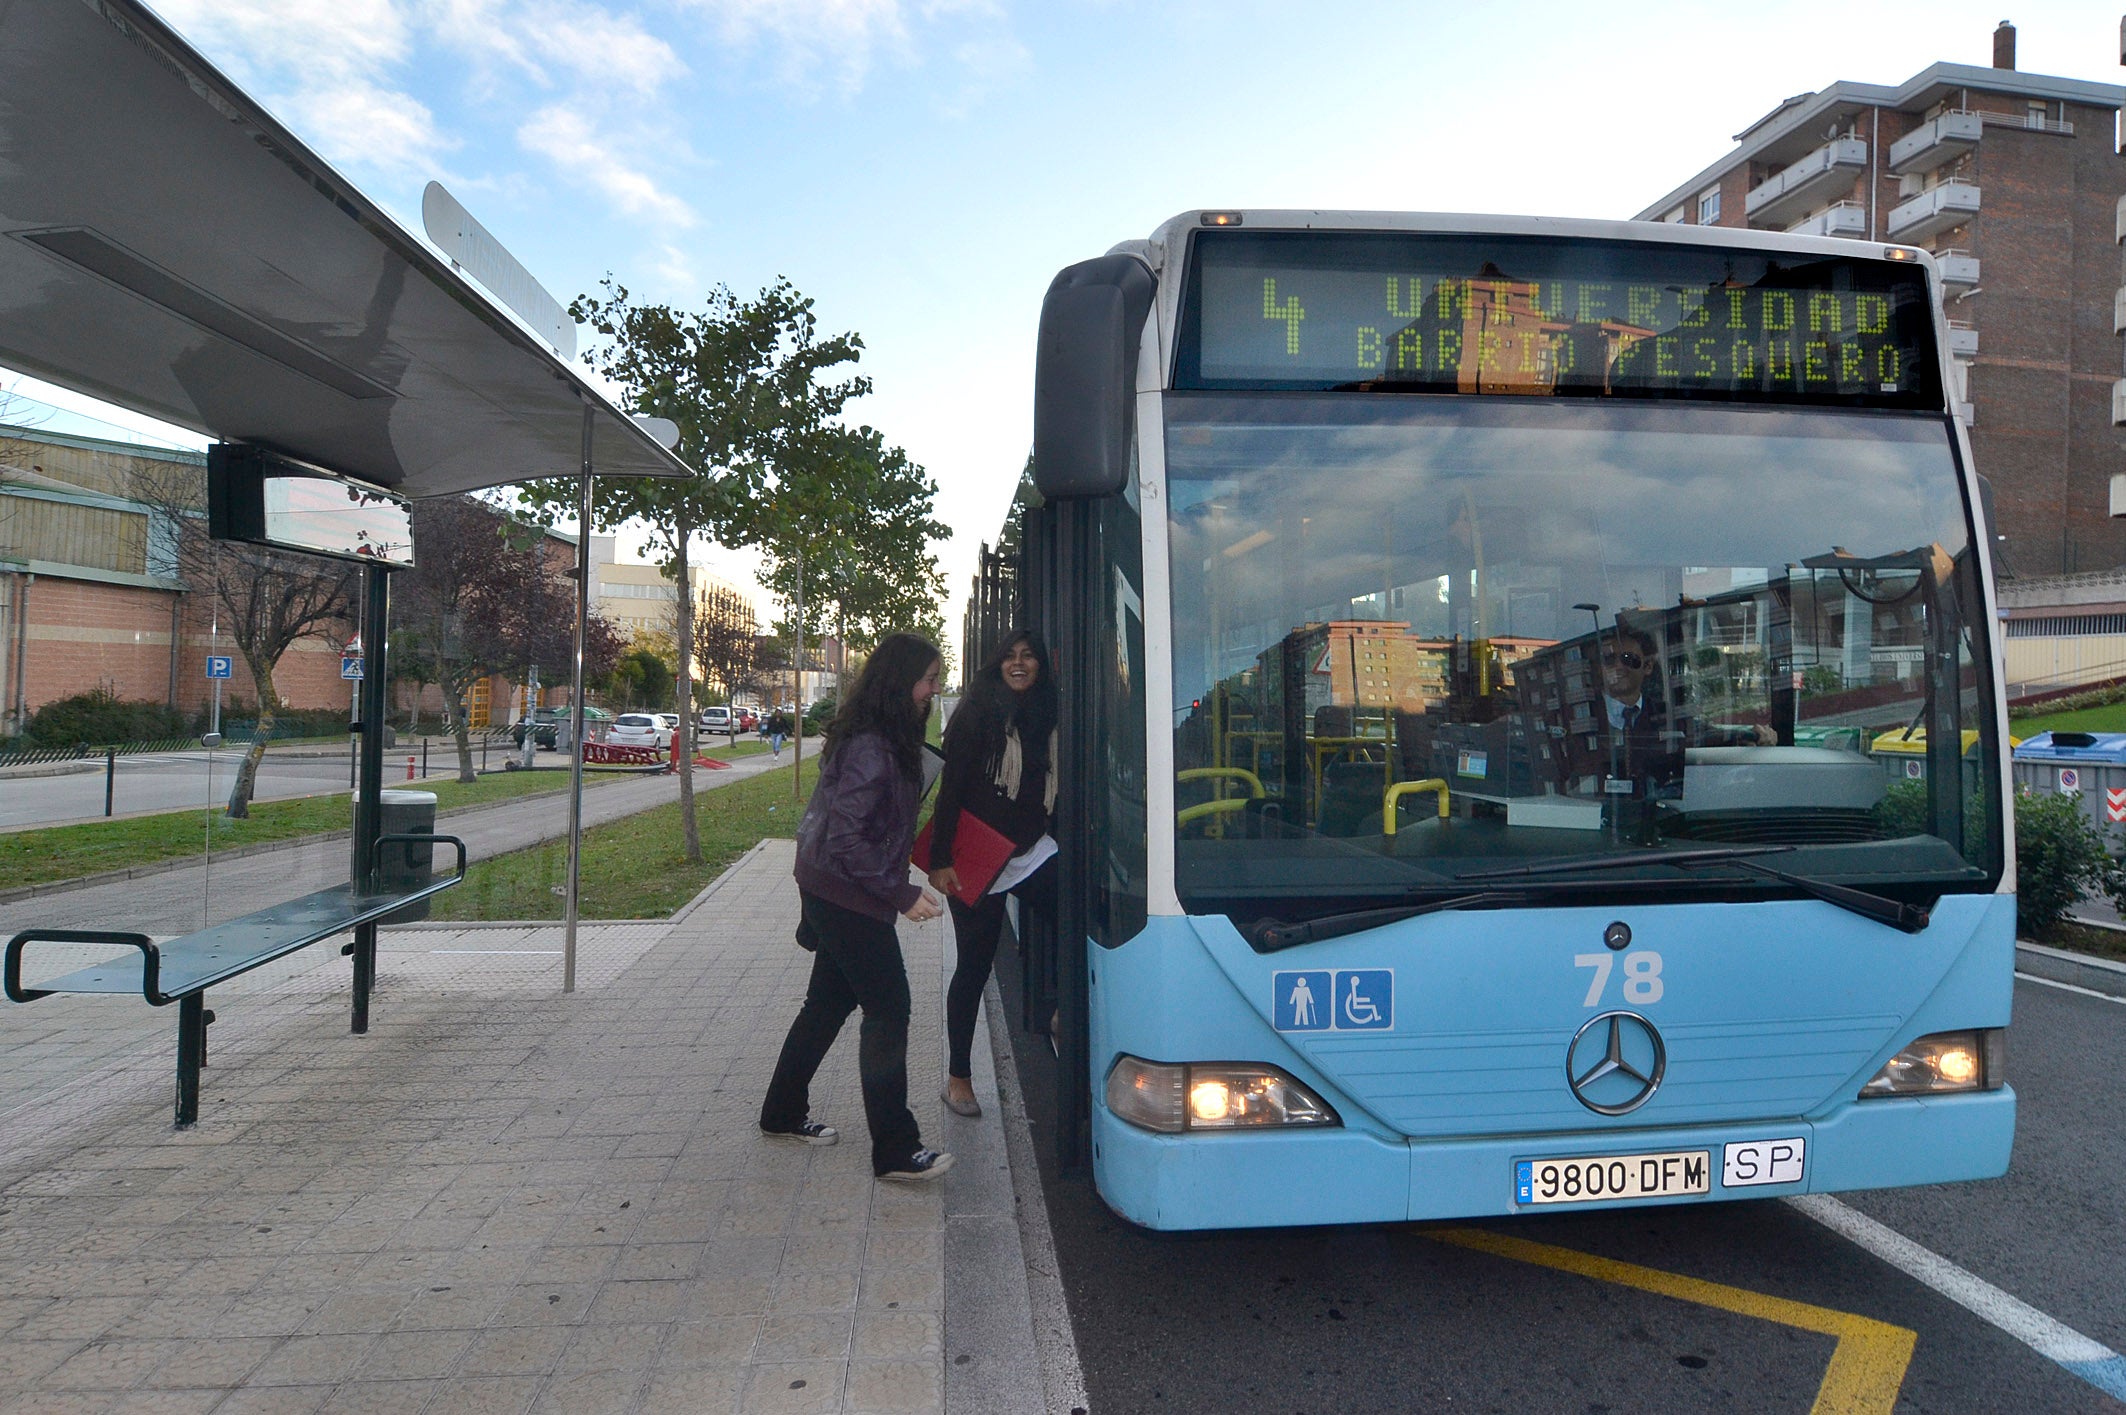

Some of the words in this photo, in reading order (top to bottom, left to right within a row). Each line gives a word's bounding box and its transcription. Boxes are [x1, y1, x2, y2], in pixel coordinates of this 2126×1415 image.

[1263, 277, 1304, 354] 4
[1386, 276, 1888, 334] UNIVERSIDAD
[1357, 326, 1575, 374] BARRIO
[1618, 335, 1900, 383] PESQUERO
[213, 659, 227, 676] P
[1574, 951, 1664, 1008] 78
[1520, 1186, 1529, 1197] E
[1541, 1162, 1626, 1198] 9800
[1640, 1156, 1702, 1192] DFM
